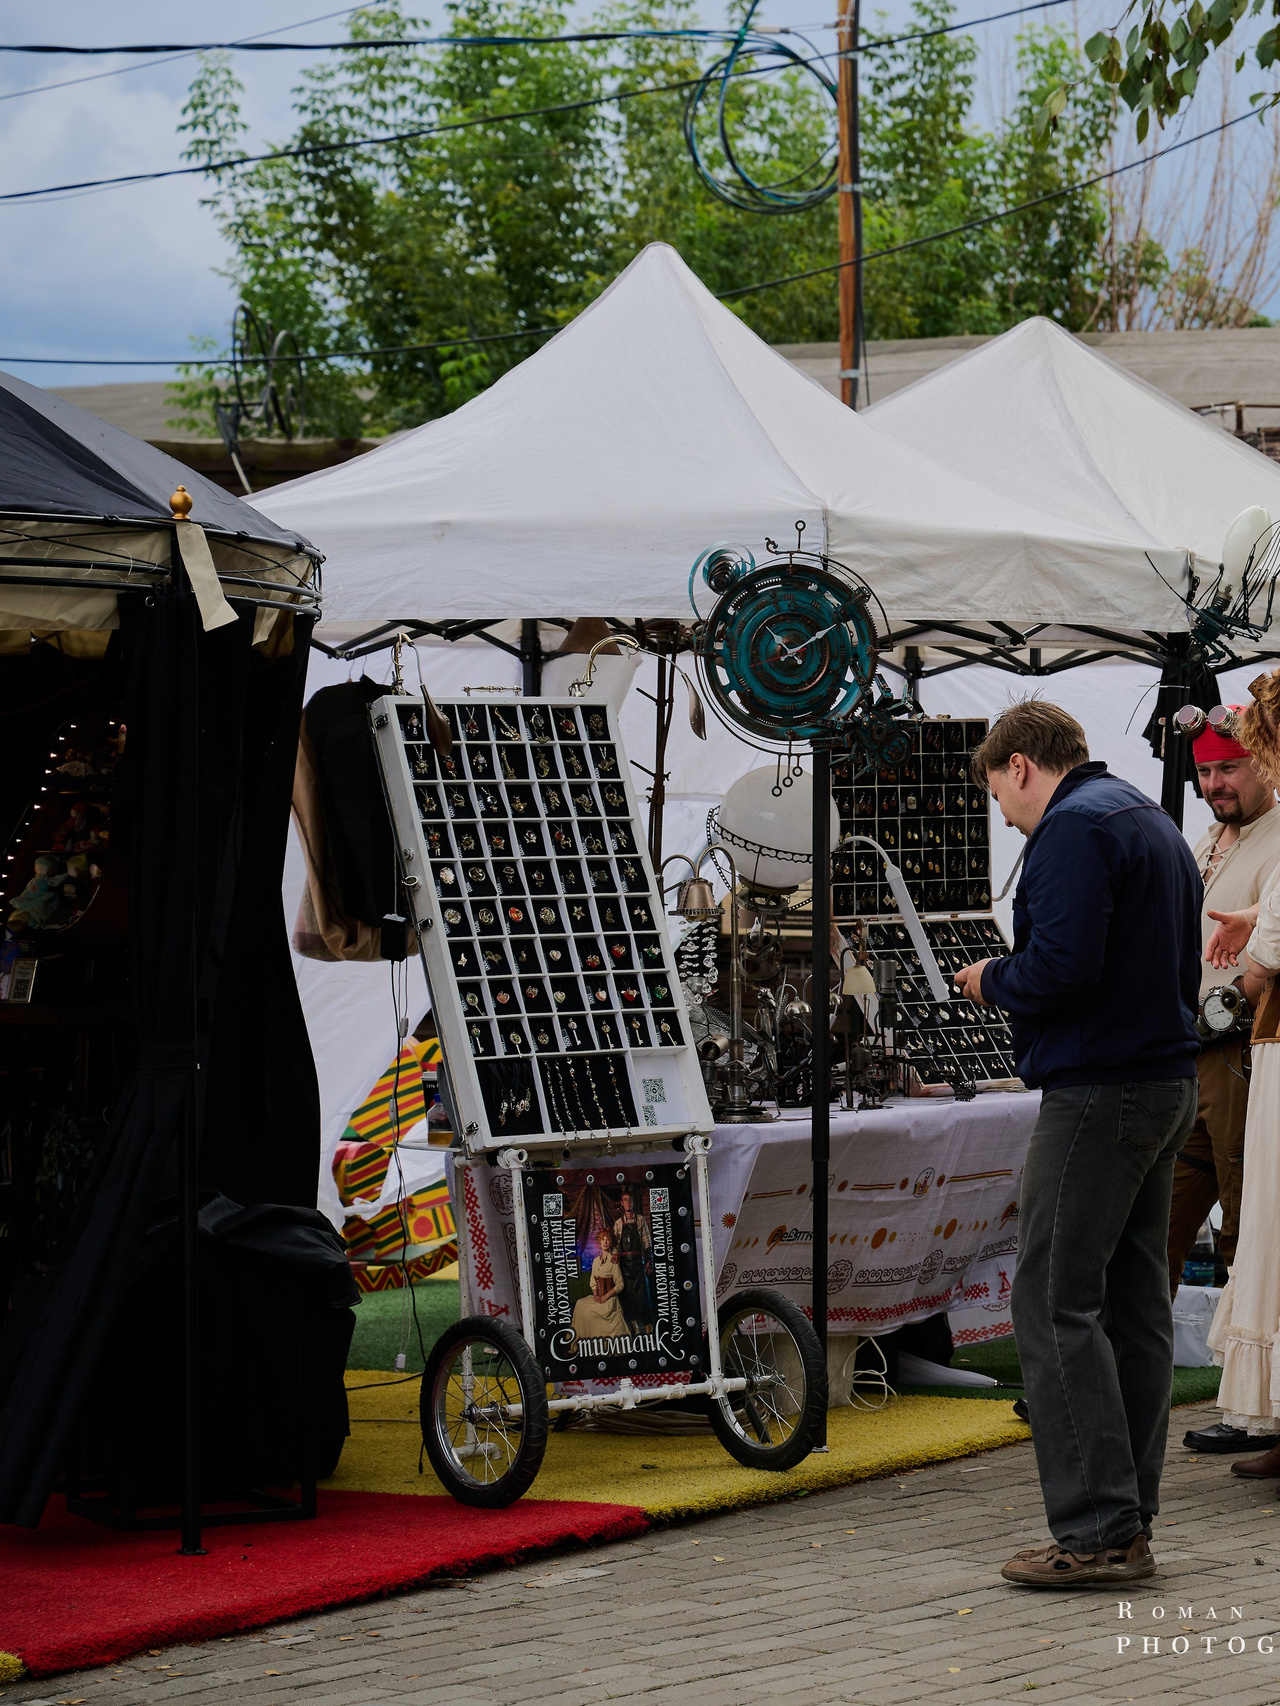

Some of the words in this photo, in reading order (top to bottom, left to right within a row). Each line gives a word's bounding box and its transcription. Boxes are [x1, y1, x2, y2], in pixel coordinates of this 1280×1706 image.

[540, 1219, 550, 1249] часов
[543, 1251, 554, 1264] из
[563, 1218, 579, 1279] ЛЯГУШКА
[651, 1213, 666, 1257] СВАЛКИ
[664, 1212, 674, 1262] металла
[545, 1267, 559, 1325] Украшения
[550, 1219, 572, 1325] ВДОХНОВЛЕННАЯ
[655, 1262, 670, 1317] ИЛЛЮЗИЯ
[668, 1265, 675, 1277] из
[669, 1280, 684, 1343] Скульптура
